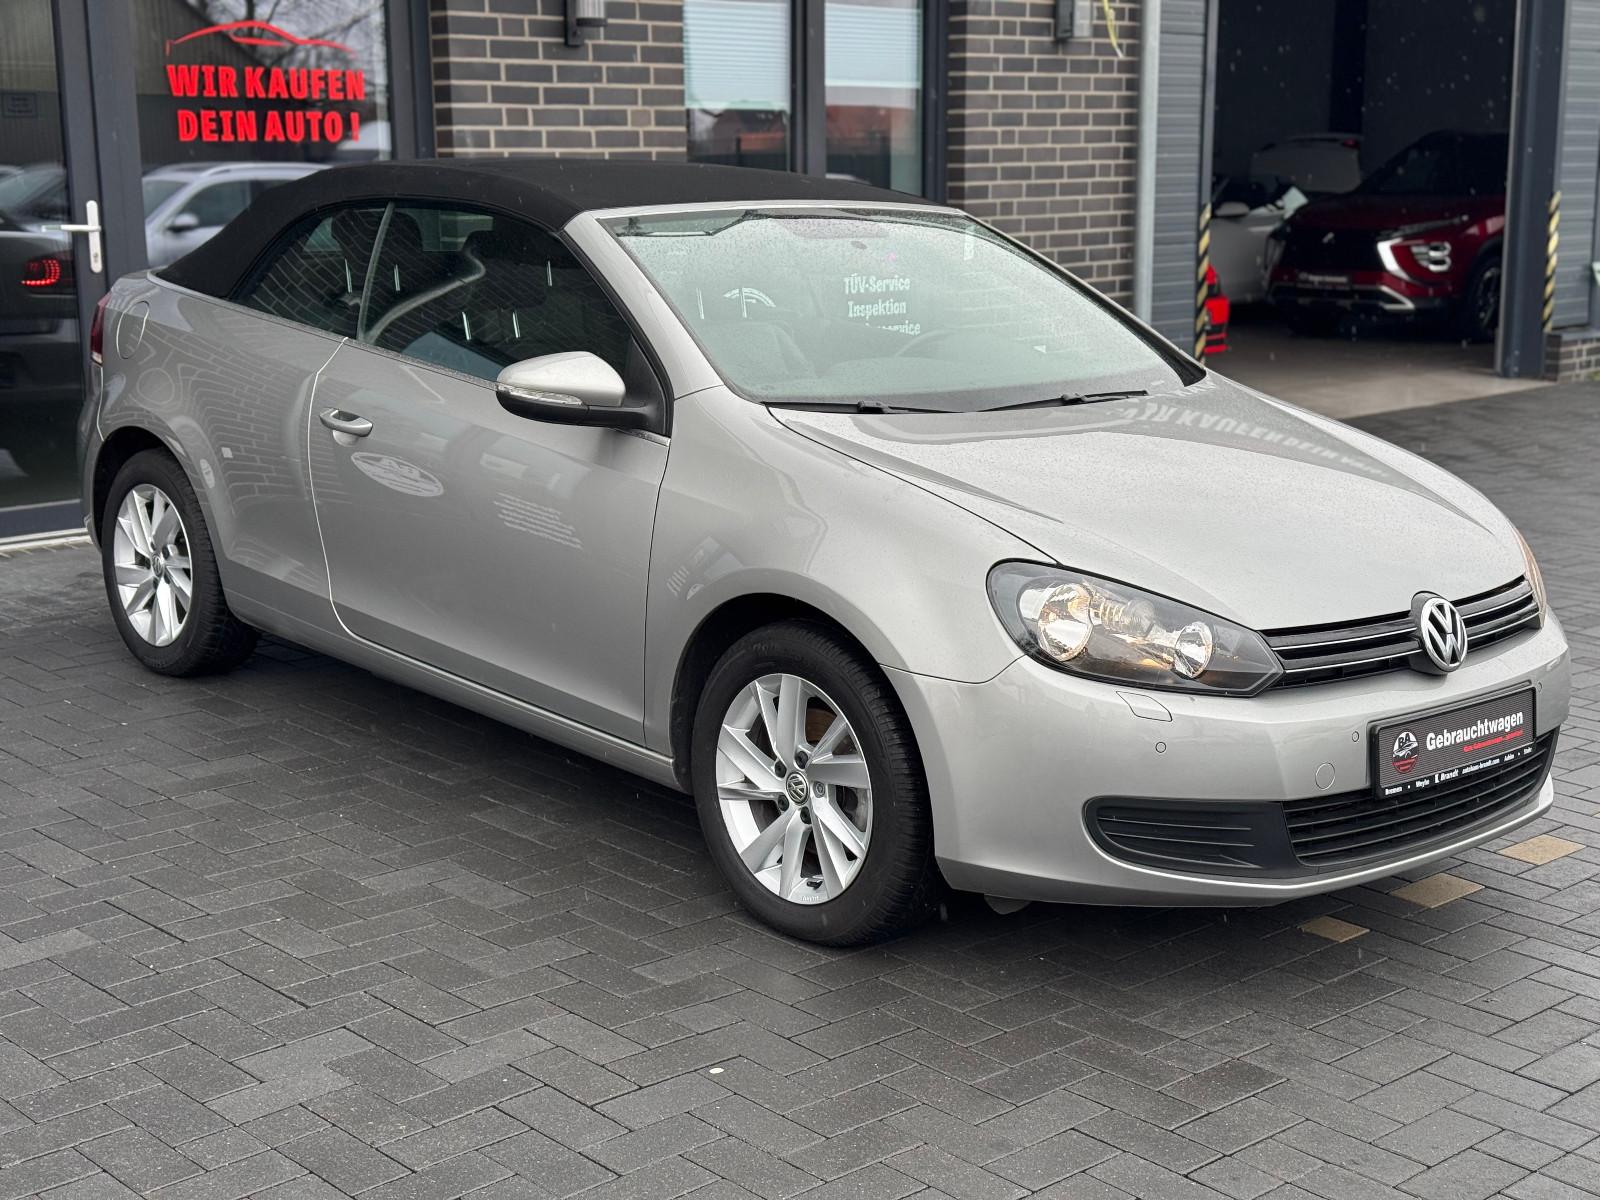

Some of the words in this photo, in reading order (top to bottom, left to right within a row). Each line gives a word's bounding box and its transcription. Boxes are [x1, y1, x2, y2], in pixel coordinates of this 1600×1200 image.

[166, 64, 239, 98] WIR
[244, 66, 366, 100] KAUFEN
[177, 109, 258, 142] DEIN
[264, 110, 344, 143] AUTO
[843, 272, 911, 295] TÜV-Service
[847, 298, 907, 320] Inspektion
[1426, 711, 1524, 751] Gebrauchtwagen
